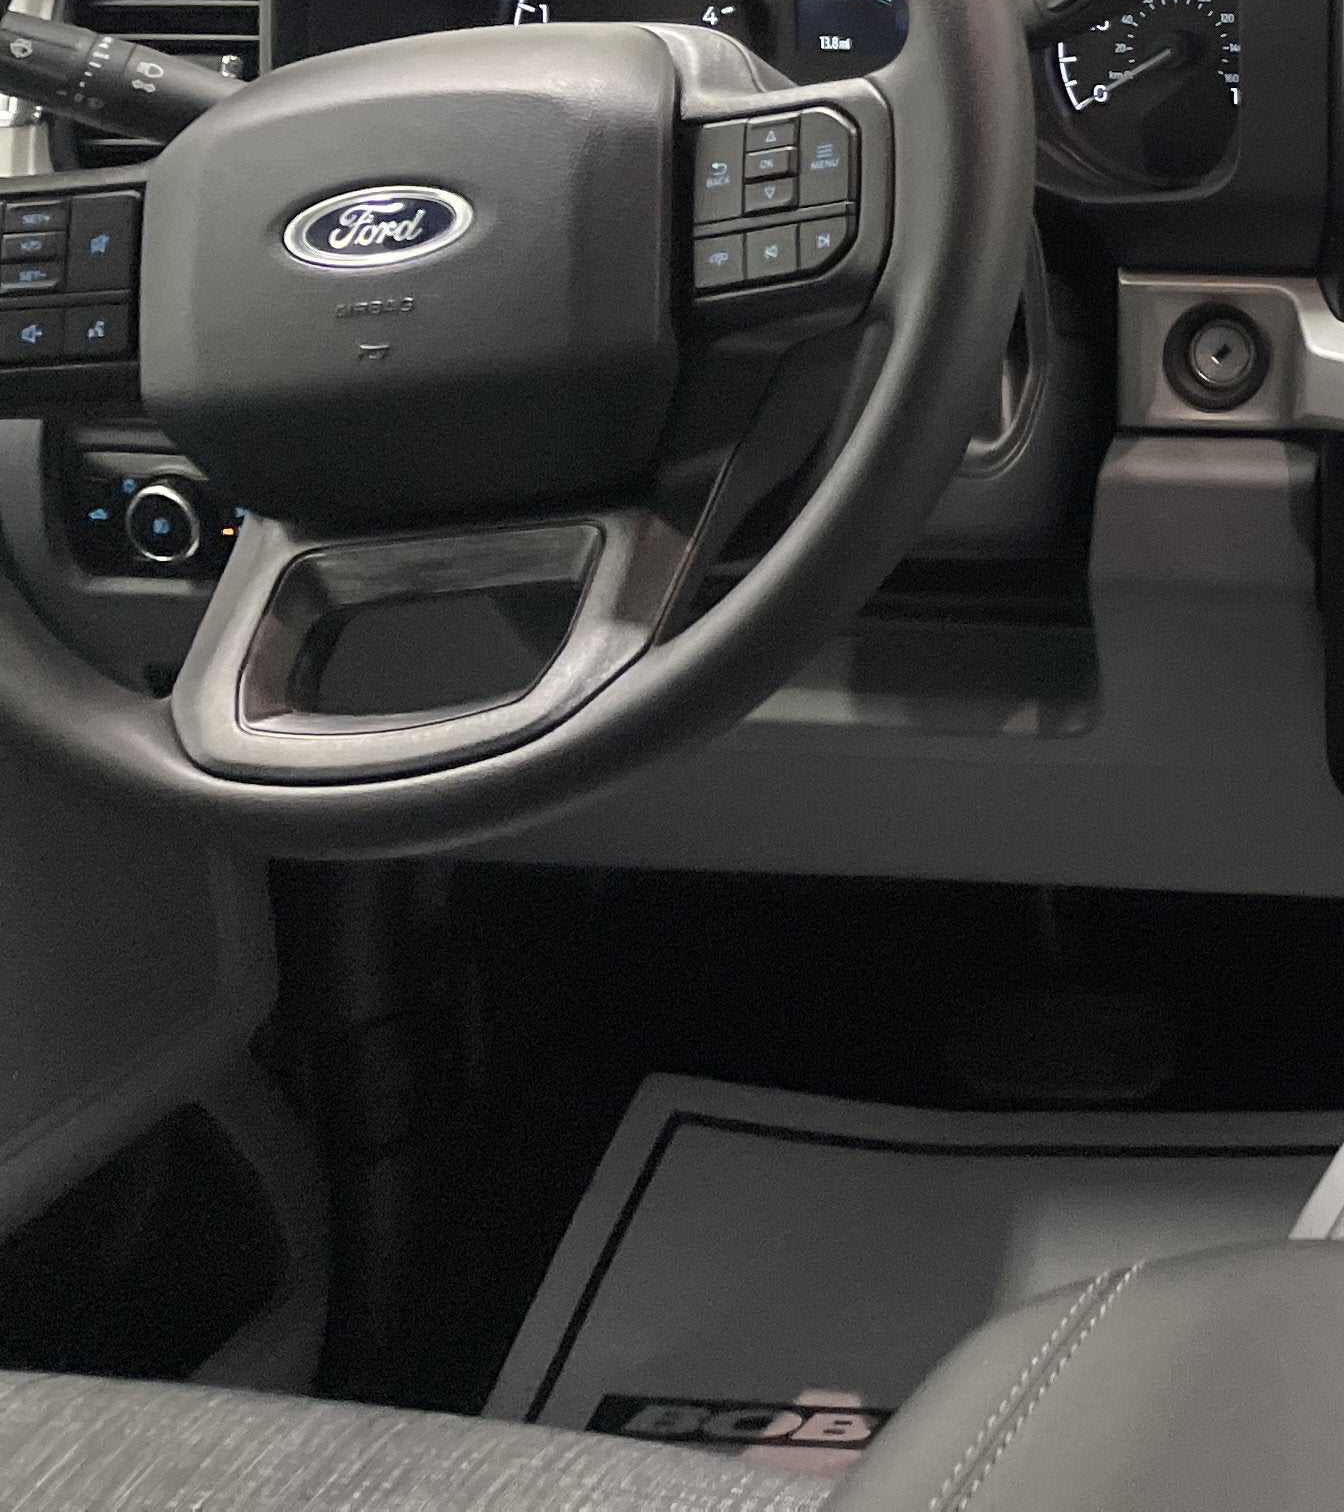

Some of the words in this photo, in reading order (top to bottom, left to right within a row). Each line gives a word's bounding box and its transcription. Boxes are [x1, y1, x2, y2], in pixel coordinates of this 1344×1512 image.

[539, 4, 549, 24] 1
[702, 6, 719, 26] 4
[810, 157, 840, 172] MENU
[328, 202, 426, 249] Ford
